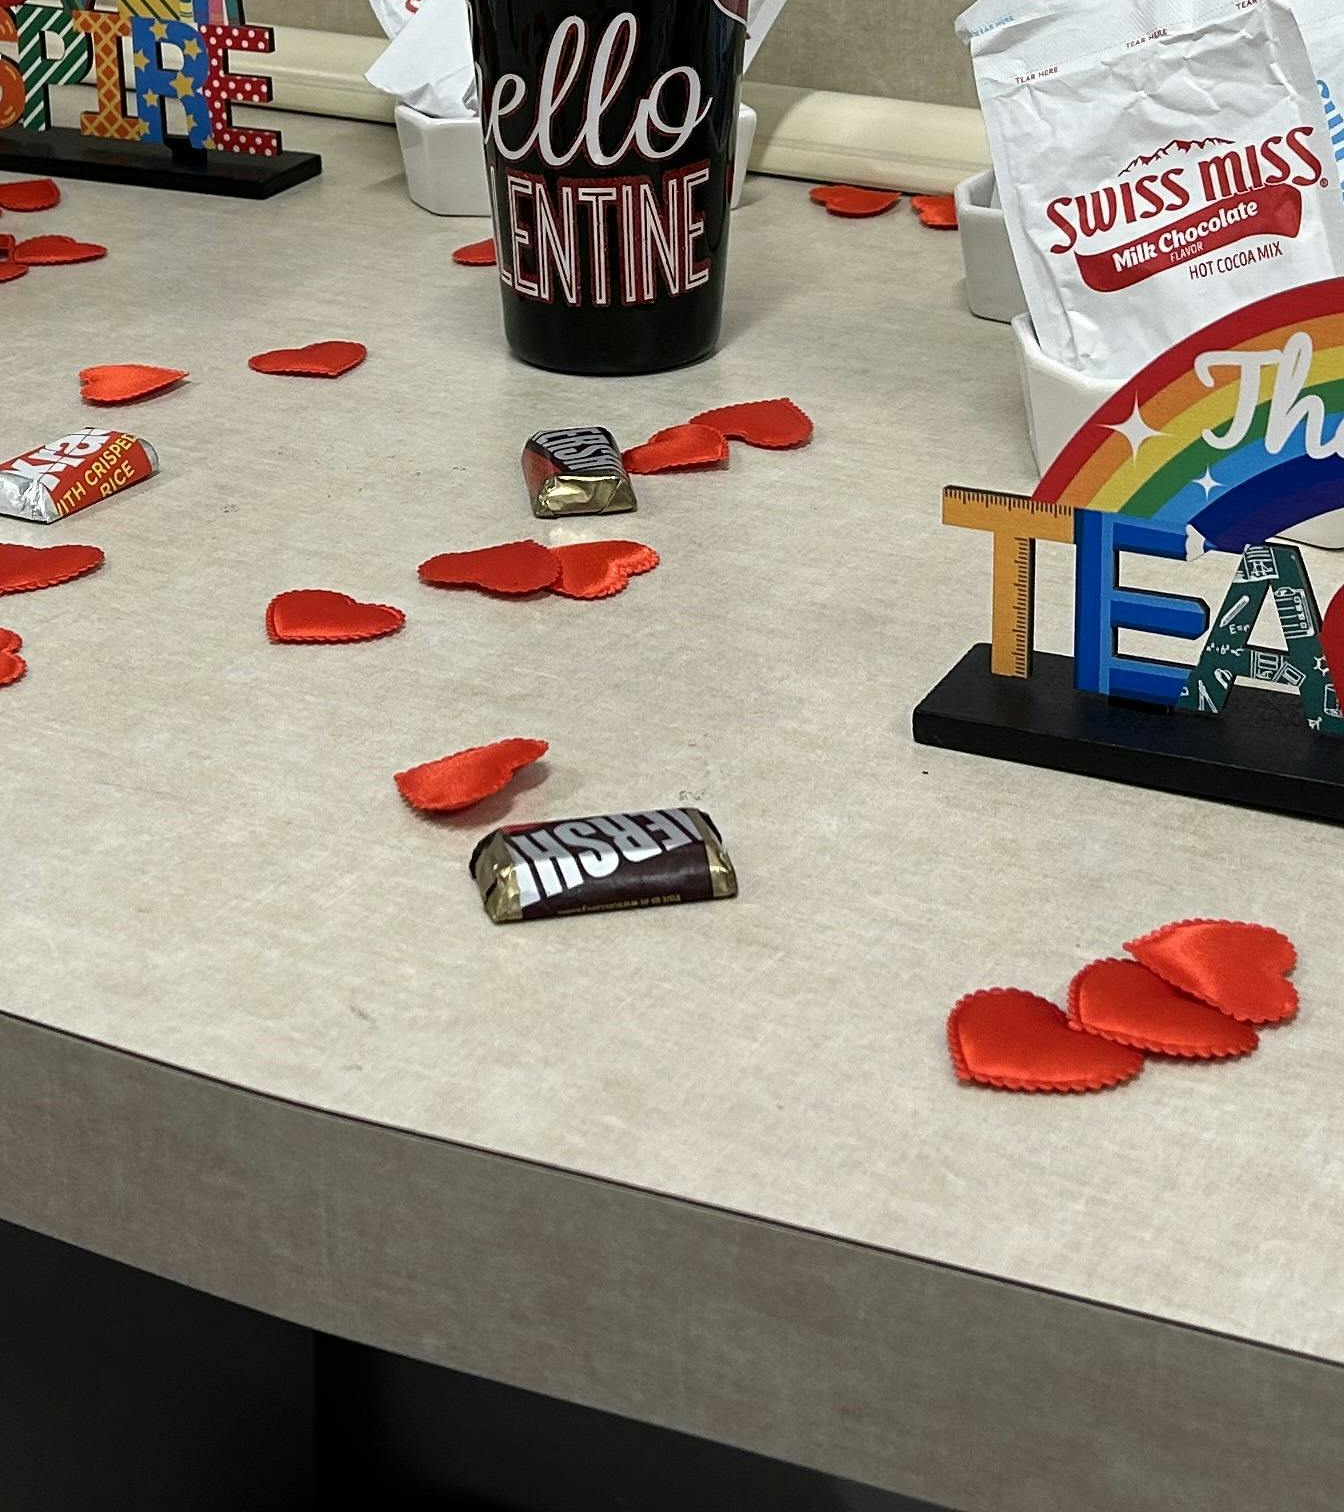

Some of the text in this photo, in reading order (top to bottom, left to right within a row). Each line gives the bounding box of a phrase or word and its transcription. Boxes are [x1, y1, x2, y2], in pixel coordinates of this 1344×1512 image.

[1126, 38, 1146, 49] TEAR
[474, 11, 713, 167] ello
[1038, 66, 1059, 78] HERE
[1047, 126, 1323, 254] SWISS MISS
[1112, 200, 1258, 274] Milk Chocolate
[1169, 241, 1203, 262] FLAVOR
[1189, 240, 1283, 281] HOT COCOA MIX
[100, 460, 134, 498] RICE
